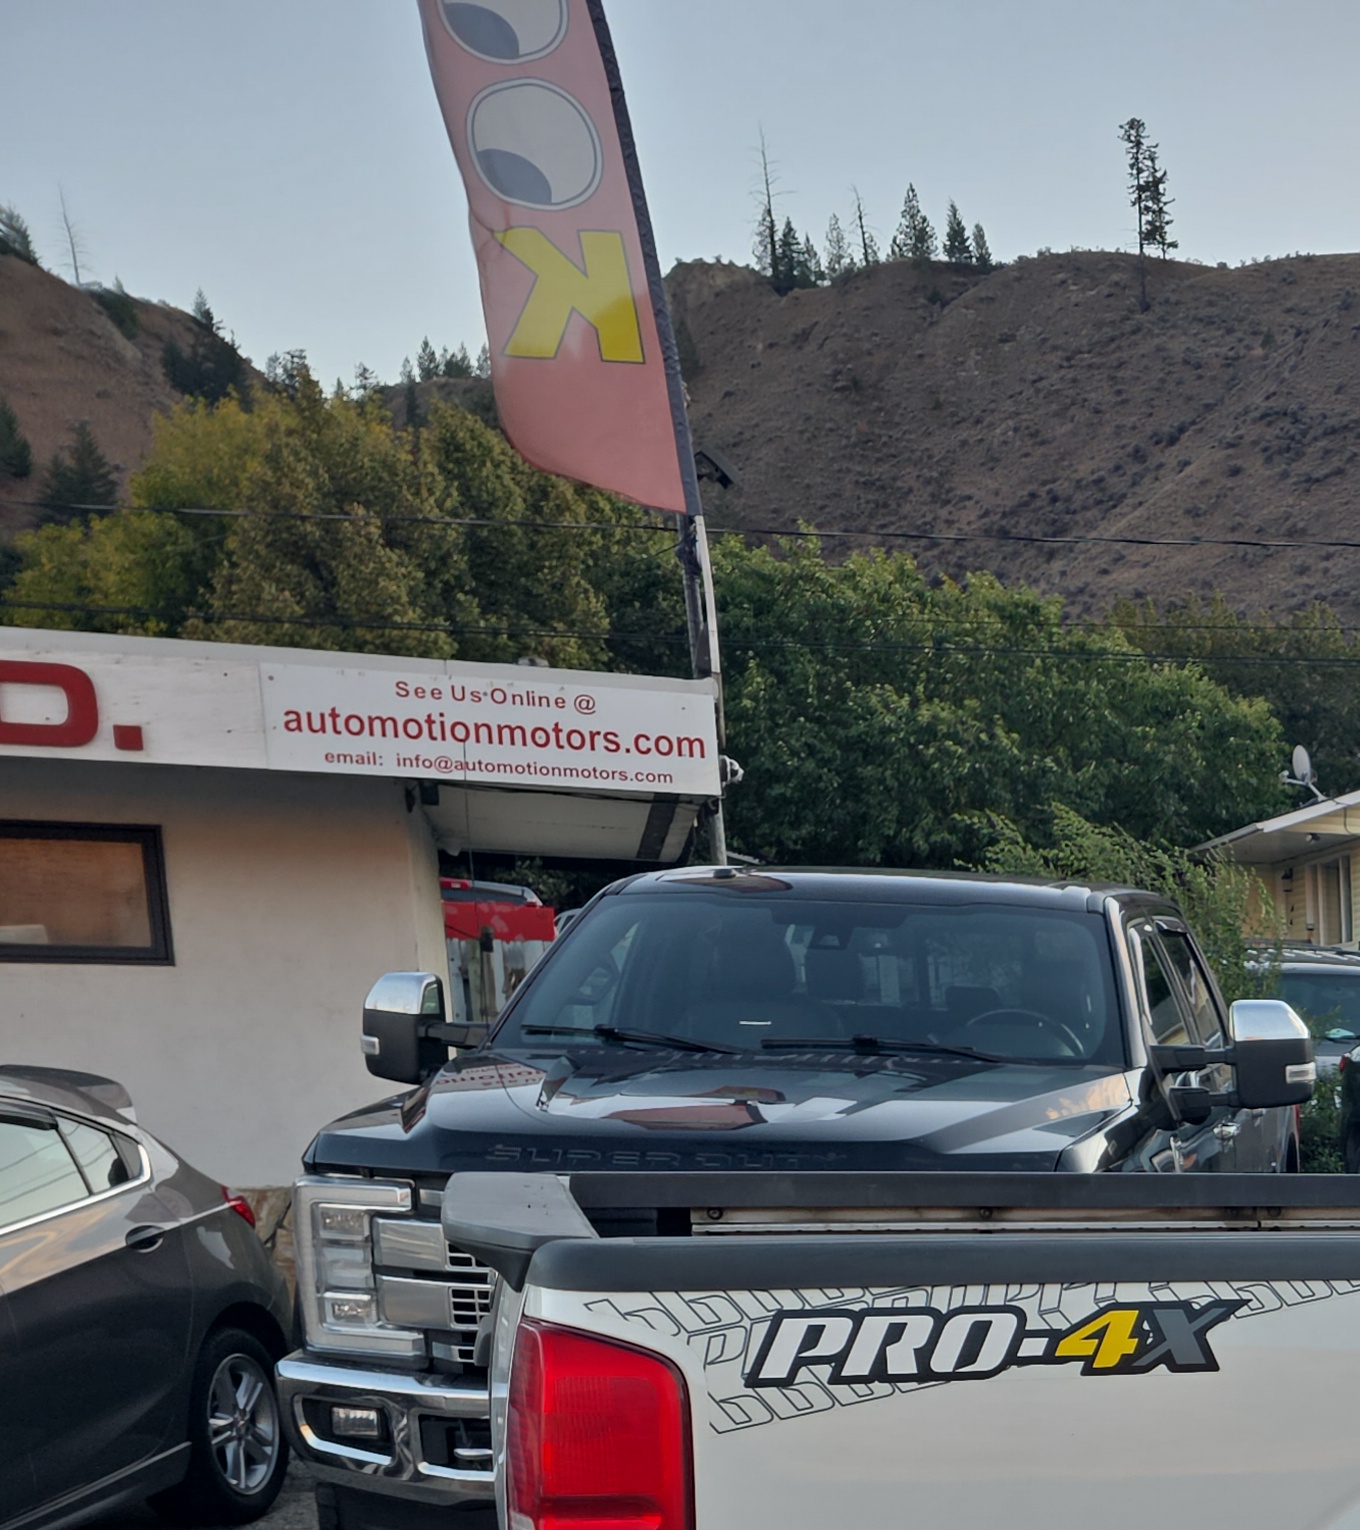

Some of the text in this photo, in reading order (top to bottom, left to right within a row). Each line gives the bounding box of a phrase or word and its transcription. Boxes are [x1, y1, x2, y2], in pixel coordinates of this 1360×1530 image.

[394, 680, 598, 716] See Us Online @
[282, 705, 707, 760] automotionmotors.com
[323, 749, 674, 785] email: info@automotionmotors.com
[484, 1143, 847, 1170] SUPER DUTY
[744, 1298, 1253, 1389] PRO-4X
